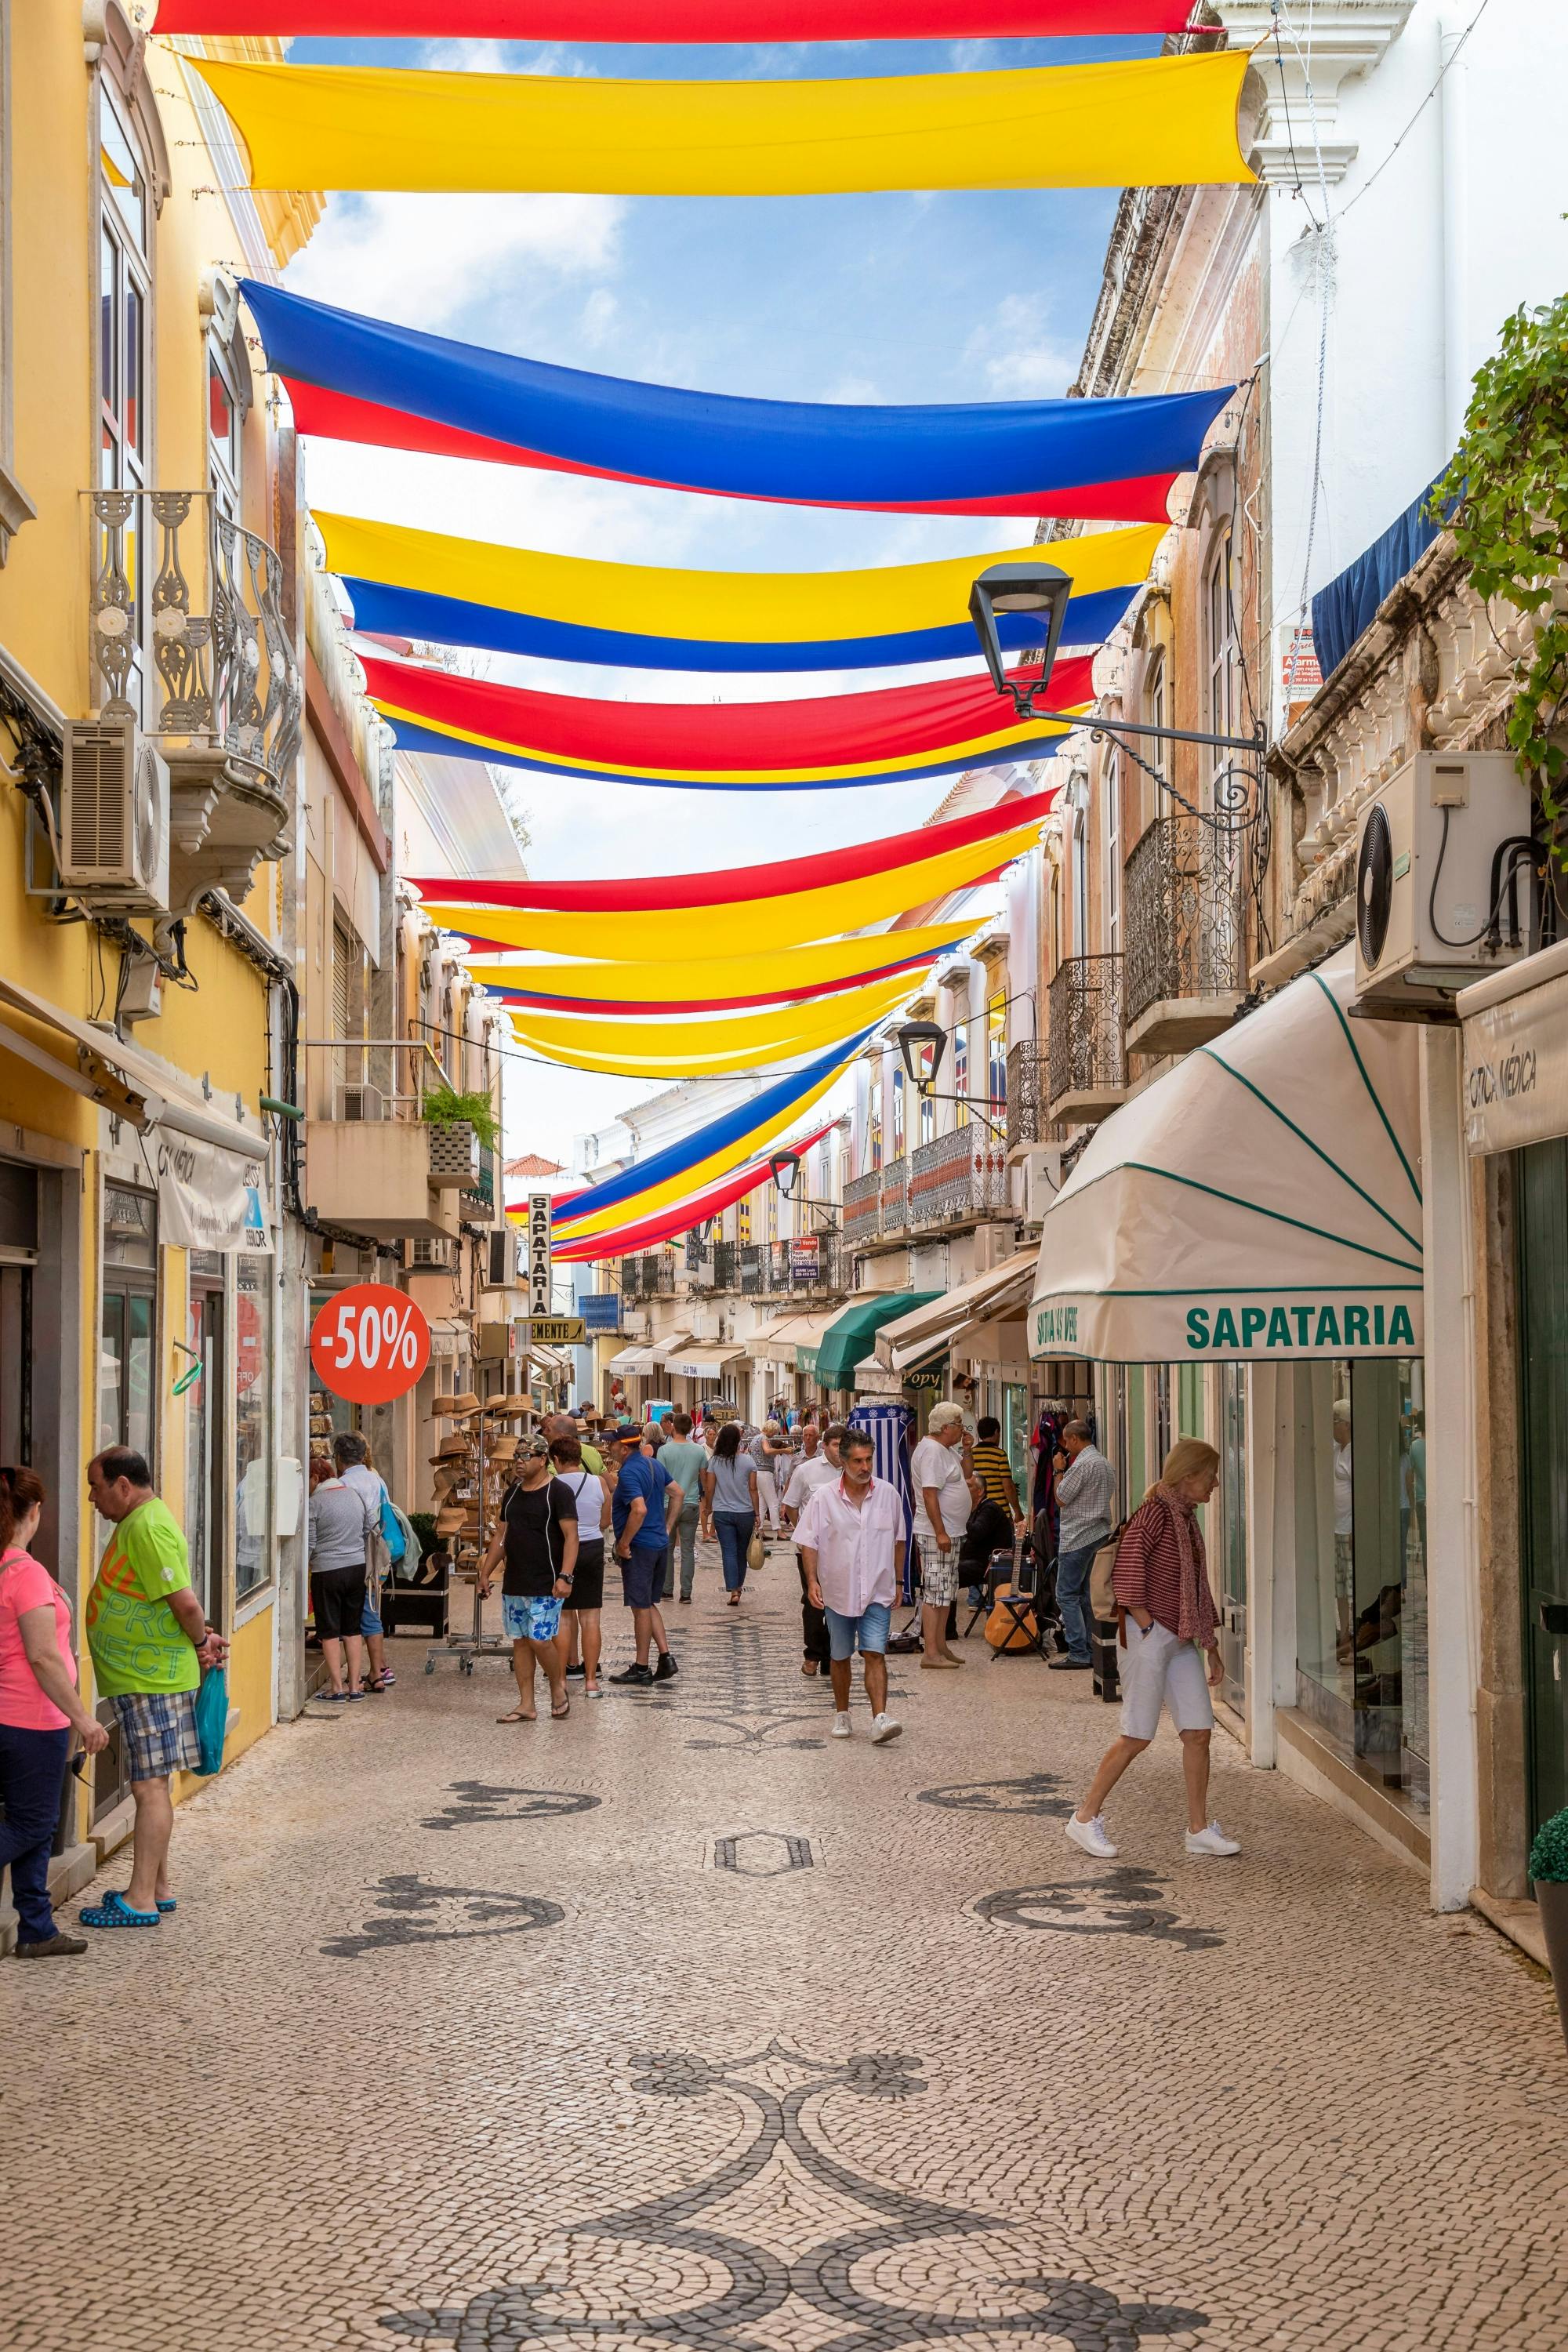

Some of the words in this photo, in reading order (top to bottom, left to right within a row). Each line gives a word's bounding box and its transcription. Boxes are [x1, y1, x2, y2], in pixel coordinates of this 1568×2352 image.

[1500, 1042, 1537, 1098] MÉDICA
[532, 1197, 547, 1314] SAPATARIA
[321, 1305, 418, 1370] -50%
[1186, 1305, 1415, 1349] SAPATARIA
[100, 1592, 182, 1639] PRO
